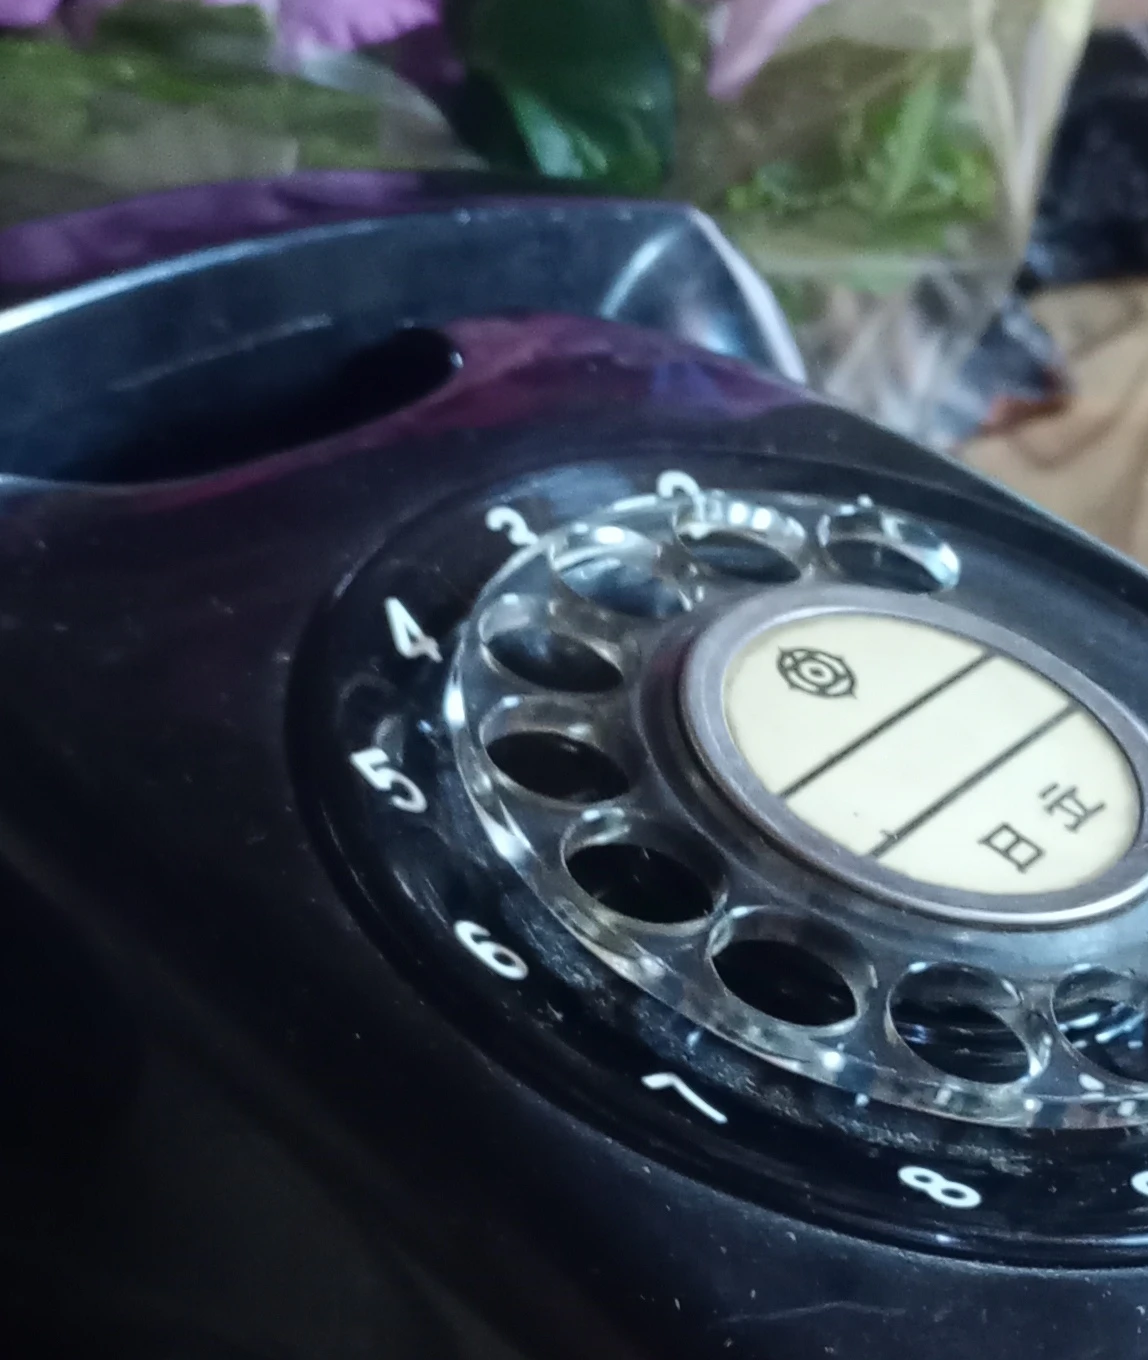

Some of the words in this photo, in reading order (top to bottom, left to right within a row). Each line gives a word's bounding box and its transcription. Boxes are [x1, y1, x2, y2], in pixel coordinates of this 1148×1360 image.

[384, 597, 443, 662] 4
[349, 746, 427, 813] 5
[977, 781, 1106, 874] 日立
[453, 919, 529, 981] 6
[641, 1072, 728, 1124] 7
[898, 1165, 983, 1209] 8
